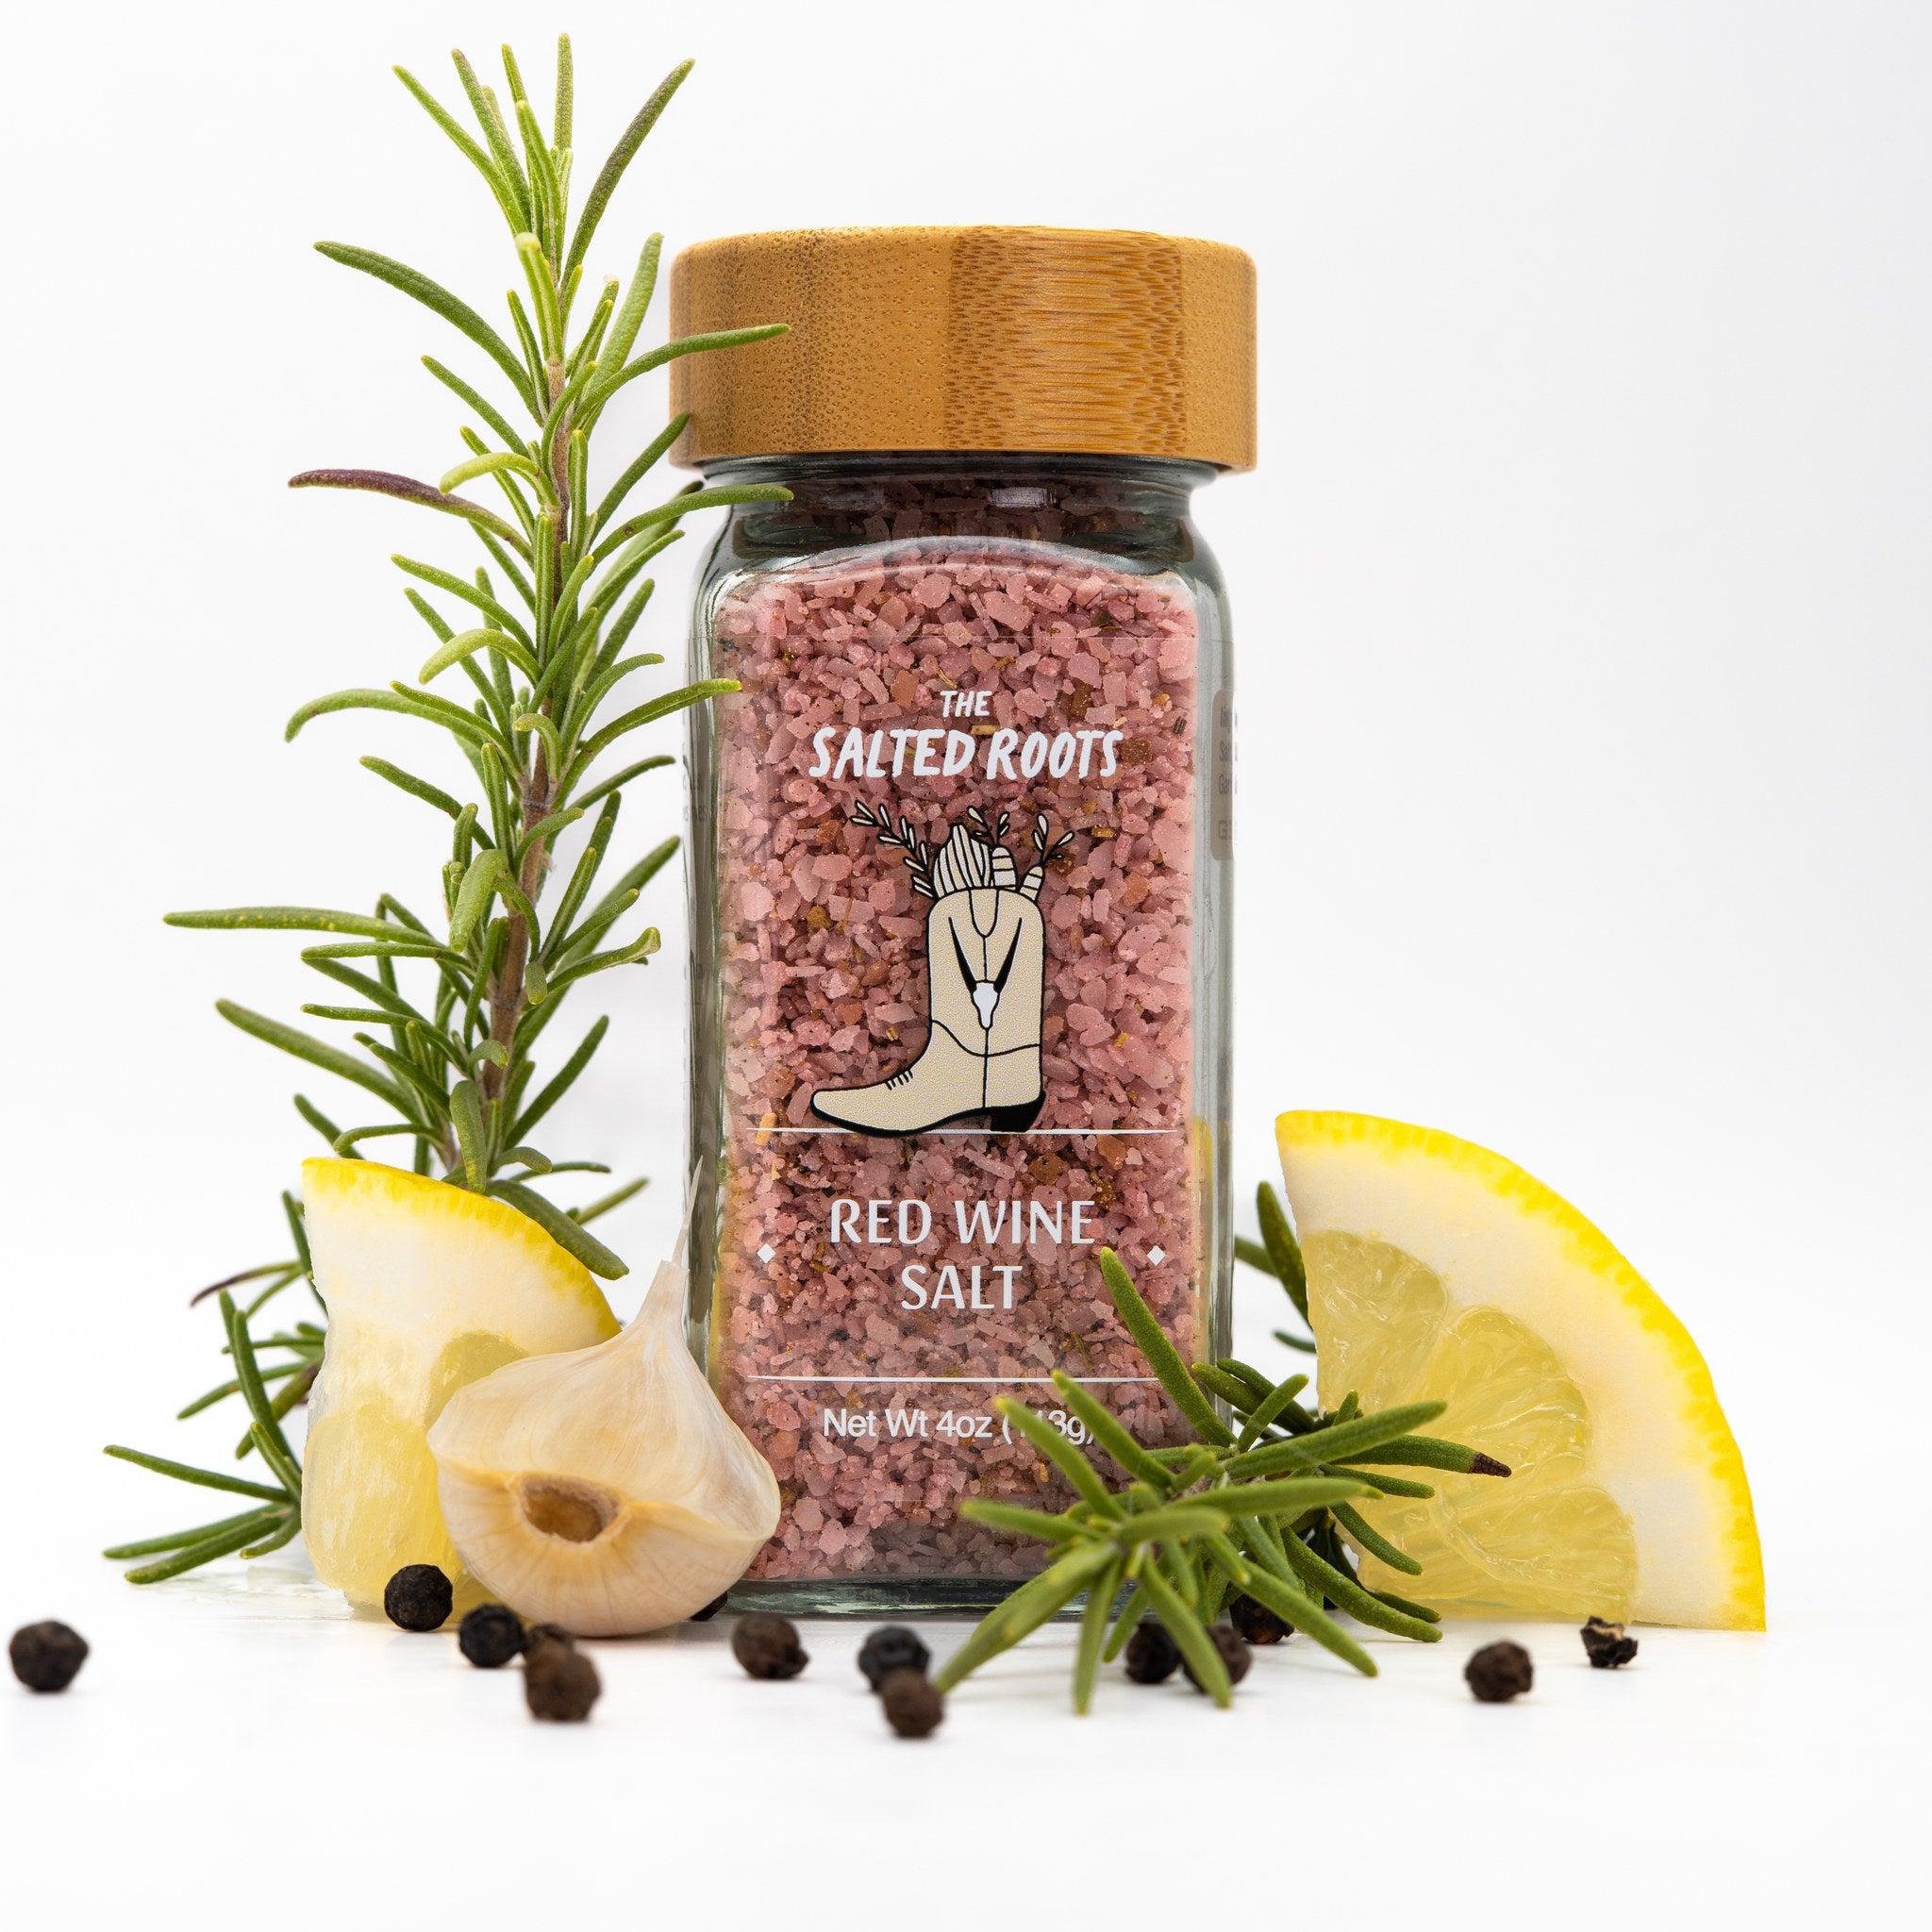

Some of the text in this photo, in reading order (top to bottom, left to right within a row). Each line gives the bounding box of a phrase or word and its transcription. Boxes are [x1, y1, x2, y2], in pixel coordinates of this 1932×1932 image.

[940, 691, 991, 718] THE
[808, 726, 1124, 780] SALTED ROOTS
[830, 1199, 1095, 1244] RED WINE
[901, 1265, 1023, 1310] SALT
[824, 1408, 876, 1437] Net
[884, 1408, 928, 1438] Wt
[936, 1410, 992, 1438] 4oz
